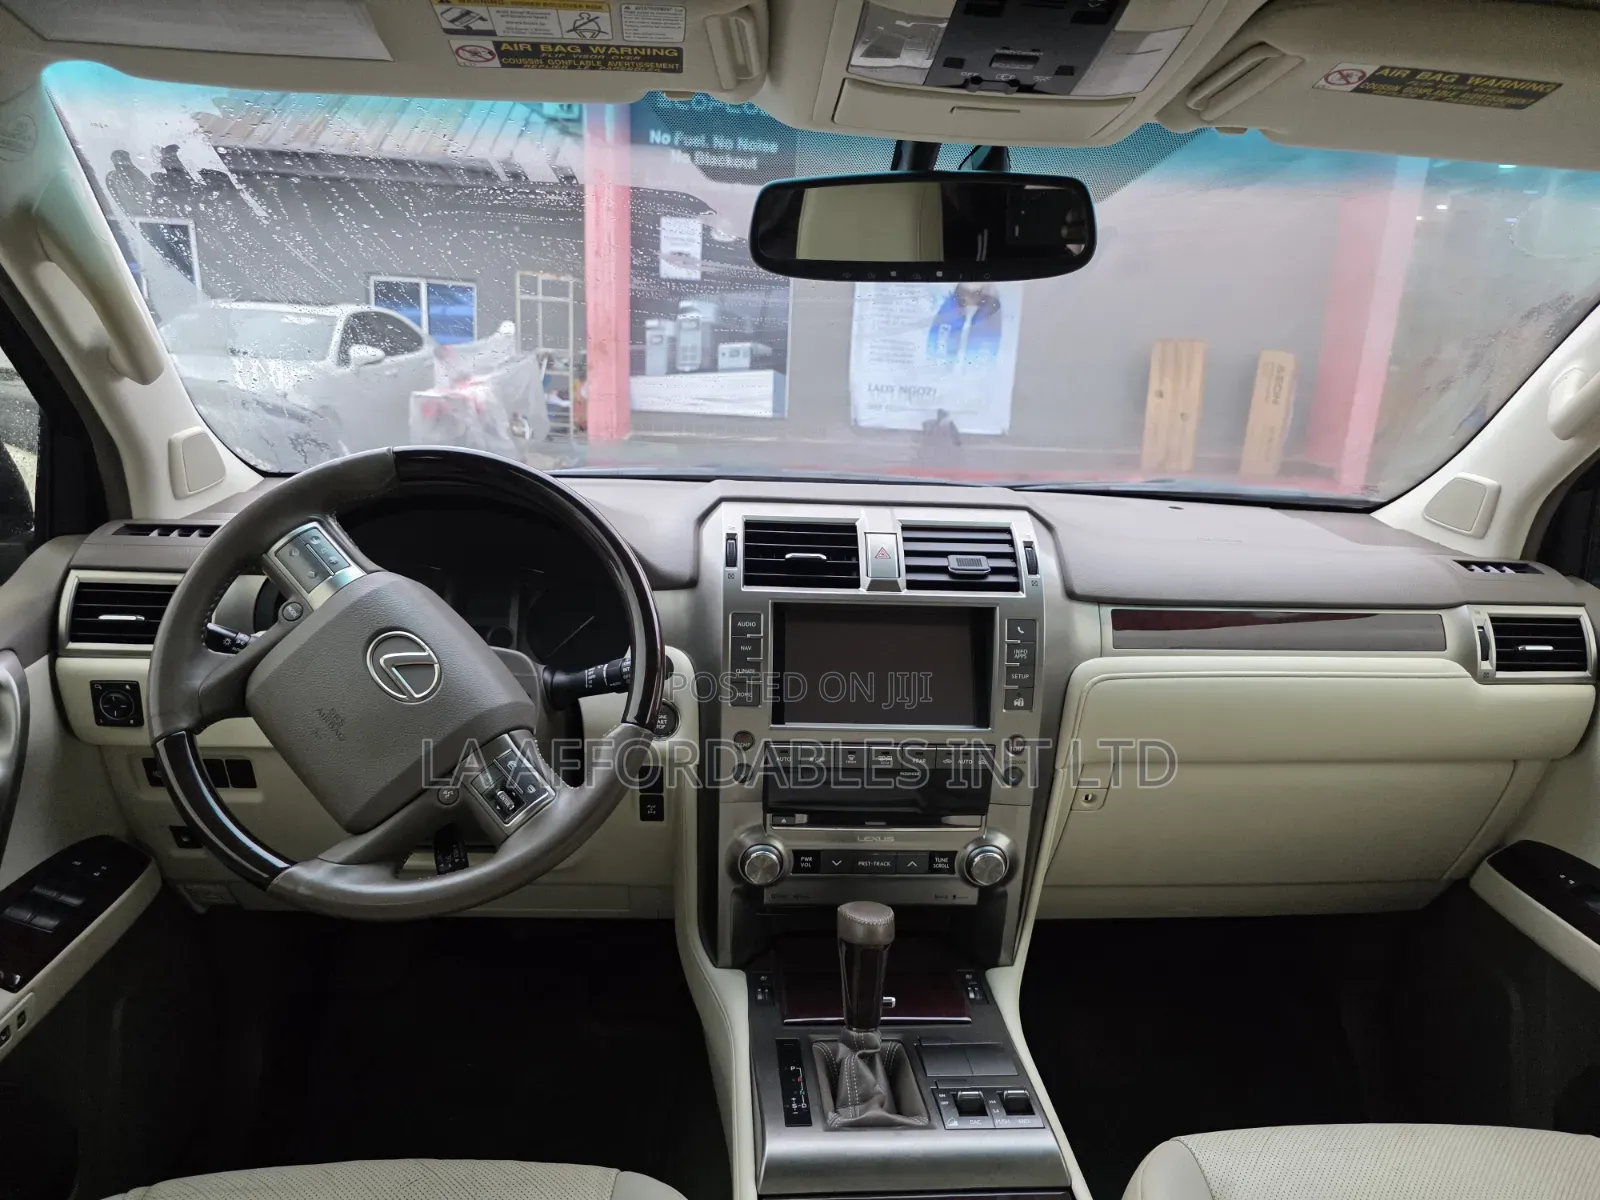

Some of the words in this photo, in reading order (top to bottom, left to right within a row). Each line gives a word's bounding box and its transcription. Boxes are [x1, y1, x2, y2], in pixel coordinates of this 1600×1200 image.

[501, 44, 532, 52] AIR
[540, 44, 581, 52] BAG
[589, 46, 678, 56] WARNING
[608, 61, 680, 70] AVERTISSEMENT
[1375, 68, 1411, 78] AIR
[1415, 71, 1460, 82] BAG
[1466, 76, 1557, 92] WARNING
[649, 130, 671, 144] No
